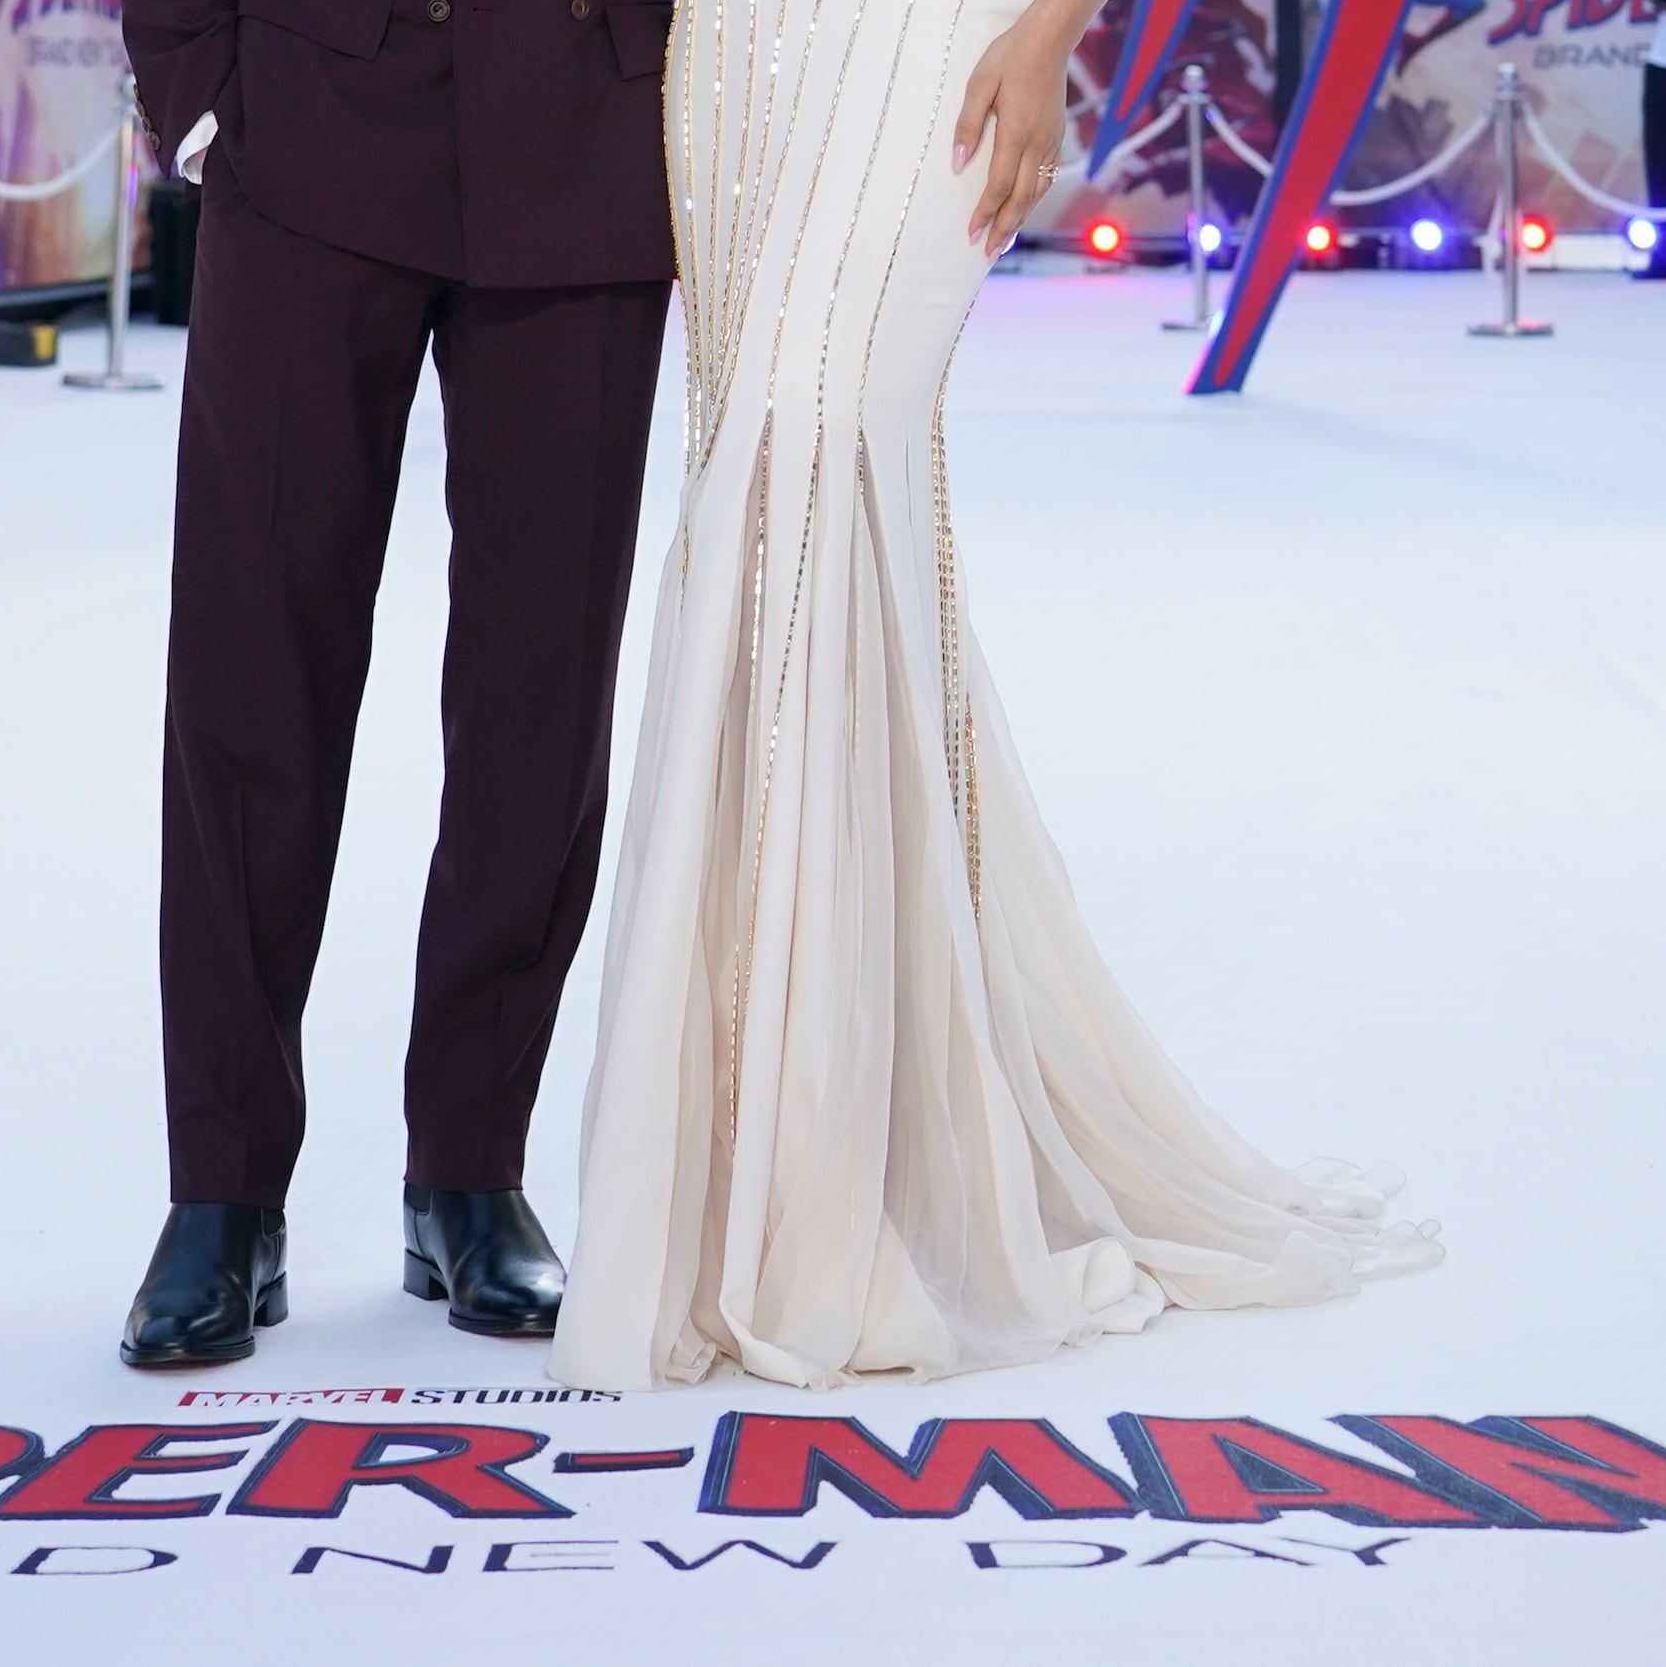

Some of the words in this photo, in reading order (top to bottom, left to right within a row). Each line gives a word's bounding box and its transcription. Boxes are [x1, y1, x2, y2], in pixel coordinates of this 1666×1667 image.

[185, 1389, 397, 1407] MARVEL
[411, 1389, 623, 1404] STUDIOS
[290, 1540, 837, 1574] NEW
[966, 1538, 1411, 1569] DAY
